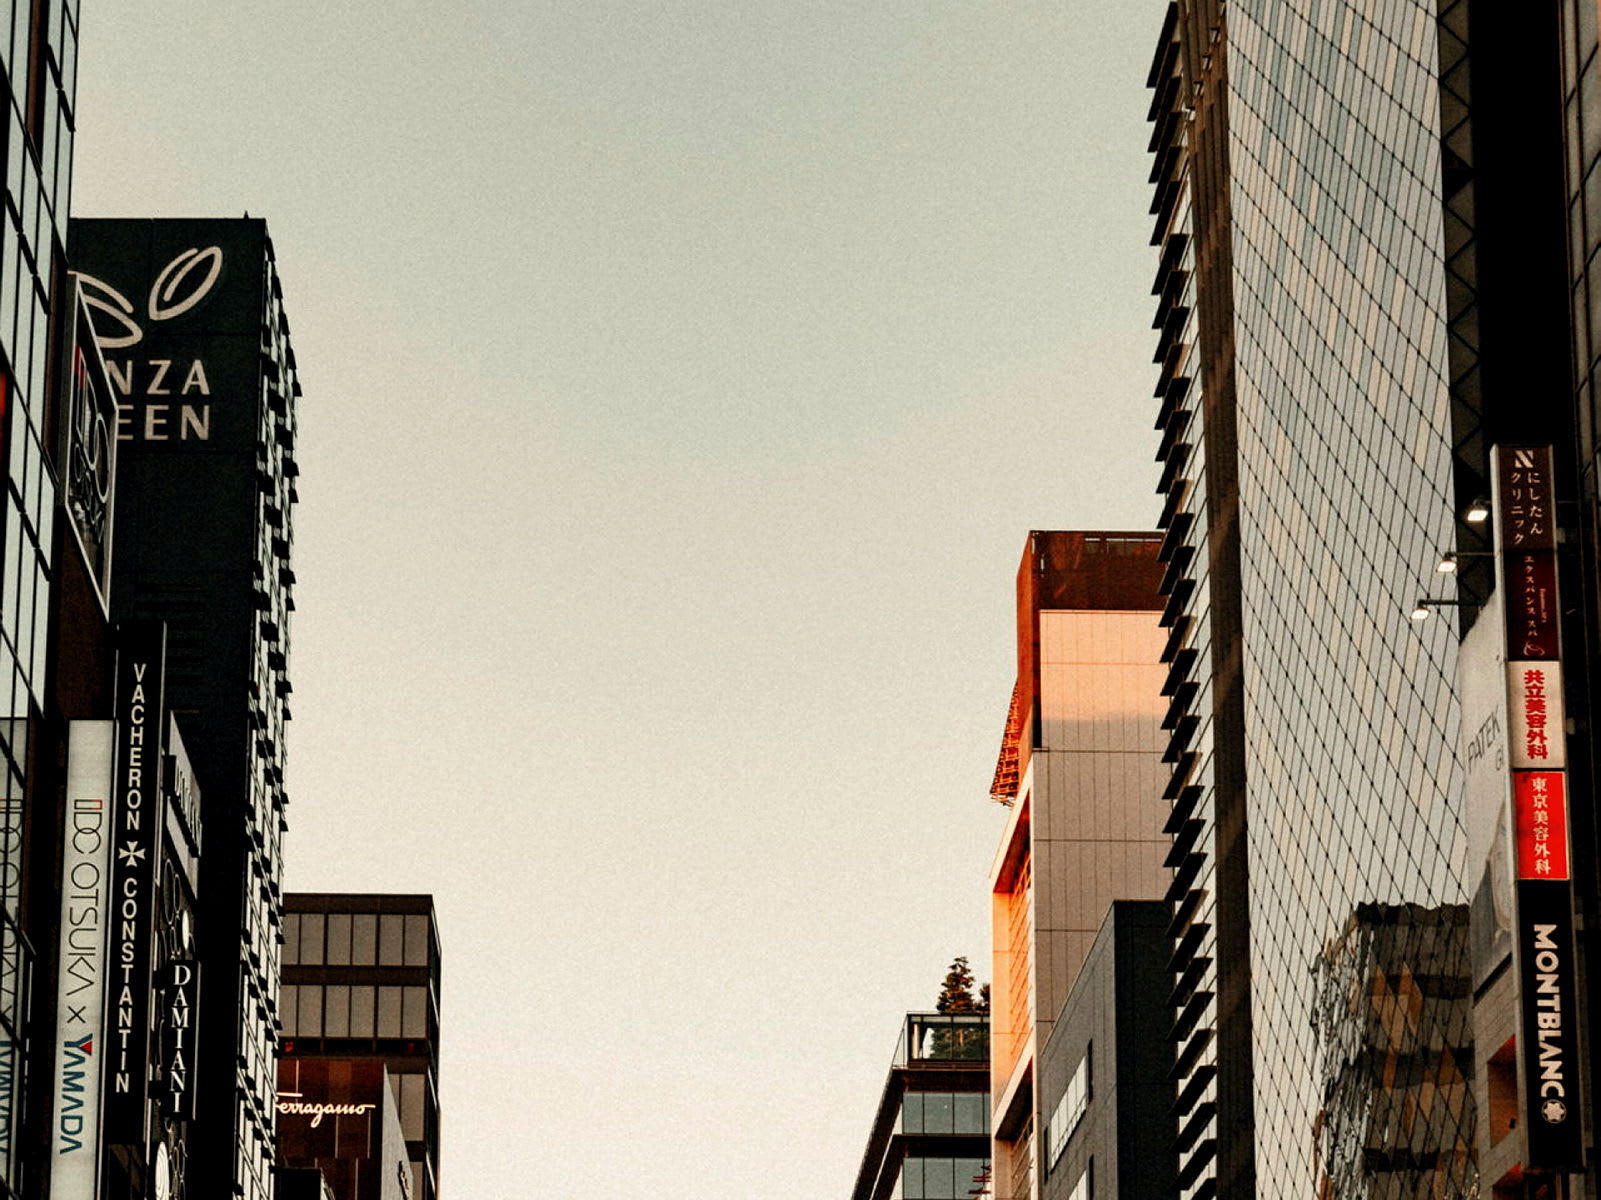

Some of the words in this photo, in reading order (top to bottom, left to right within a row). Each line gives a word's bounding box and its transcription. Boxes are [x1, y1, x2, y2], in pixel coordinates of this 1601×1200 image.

[107, 359, 211, 396] NZA
[117, 404, 211, 441] EEN
[1511, 471, 1525, 544] クリニック
[1527, 471, 1543, 535] にしたん
[126, 662, 147, 831] VACHERON
[1524, 670, 1548, 759] 共立美容外科
[1532, 777, 1552, 875] 東京美容外科
[66, 862, 100, 996] OTSUKA
[115, 877, 138, 1094] CONSTANTIN
[170, 965, 191, 1113] DAMIANI
[1533, 924, 1565, 1098] MONTBLANC
[59, 1033, 93, 1155] YAMADA
